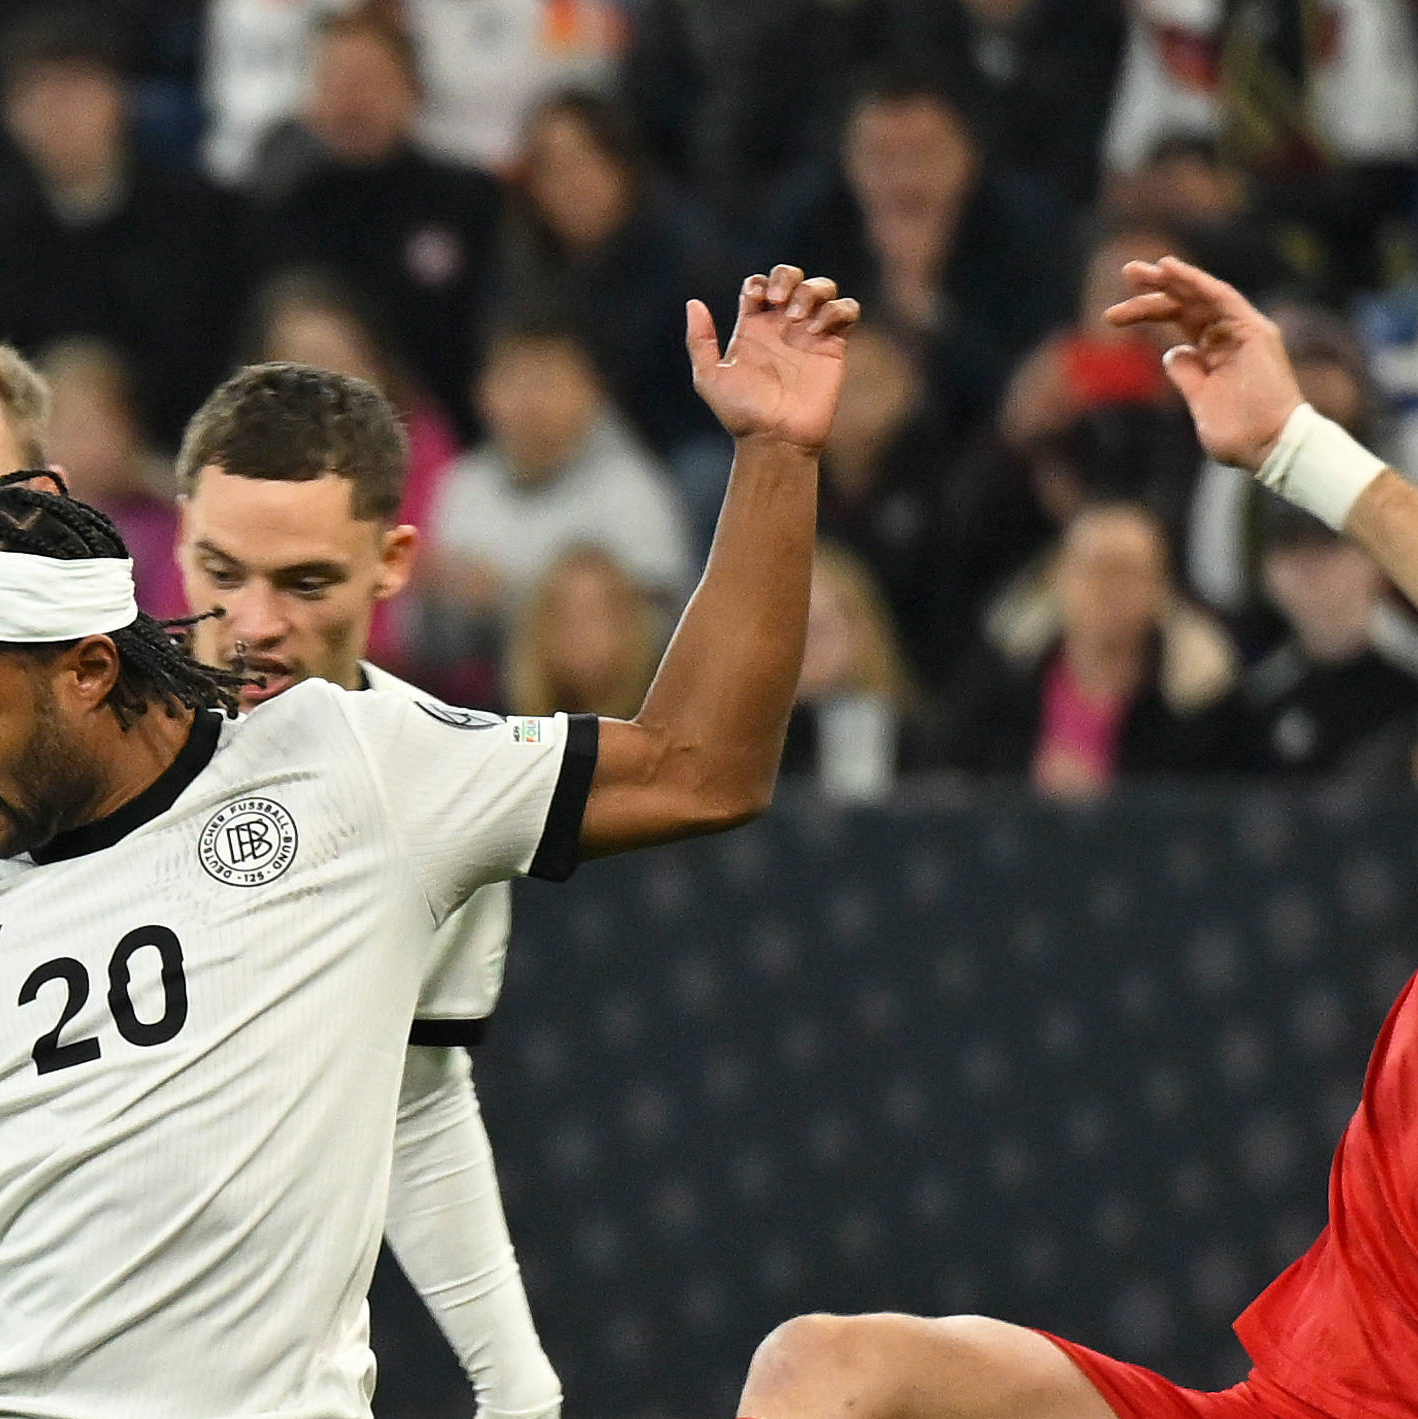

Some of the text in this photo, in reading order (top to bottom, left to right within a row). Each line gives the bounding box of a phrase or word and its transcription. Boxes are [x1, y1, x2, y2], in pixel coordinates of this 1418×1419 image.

[203, 815, 232, 878] DEUTSCHER
[244, 871, 265, 882] 125
[18, 924, 189, 1076] 20
